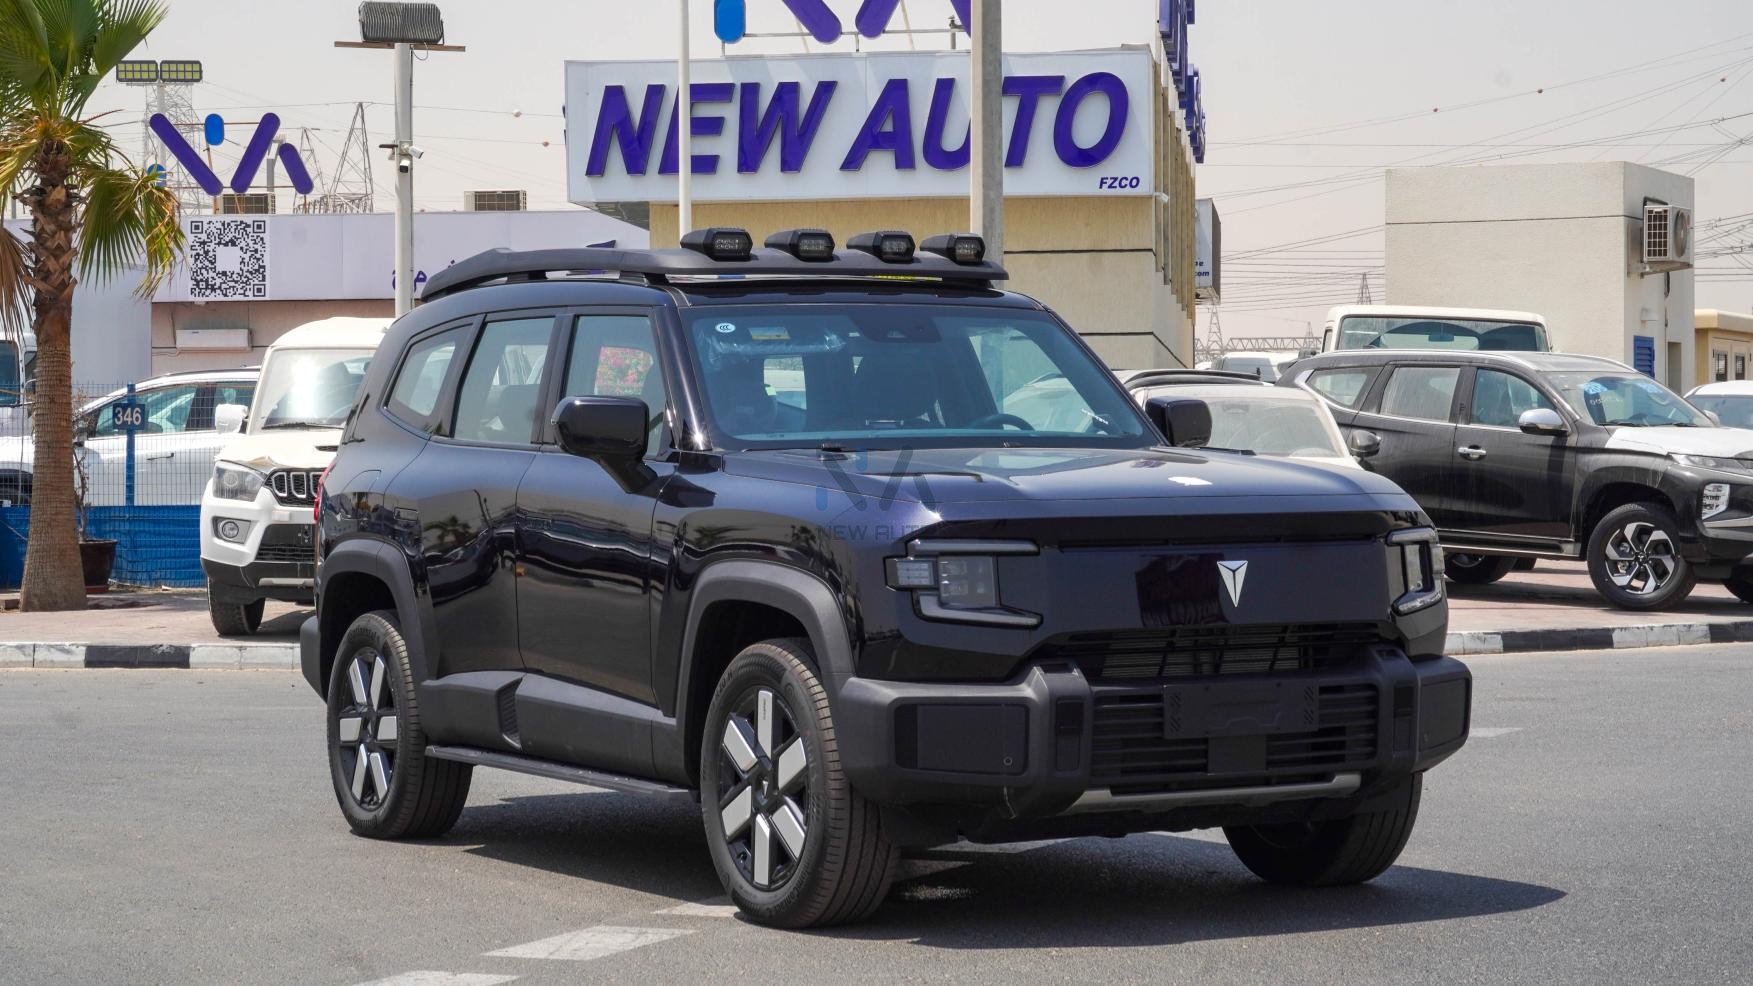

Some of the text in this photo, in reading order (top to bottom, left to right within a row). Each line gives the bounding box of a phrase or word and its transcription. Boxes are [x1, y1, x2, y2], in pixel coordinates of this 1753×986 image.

[585, 80, 838, 176] NEW
[840, 71, 1130, 171] AUTO
[1099, 176, 1140, 189] FZCO
[114, 407, 142, 425] 346
